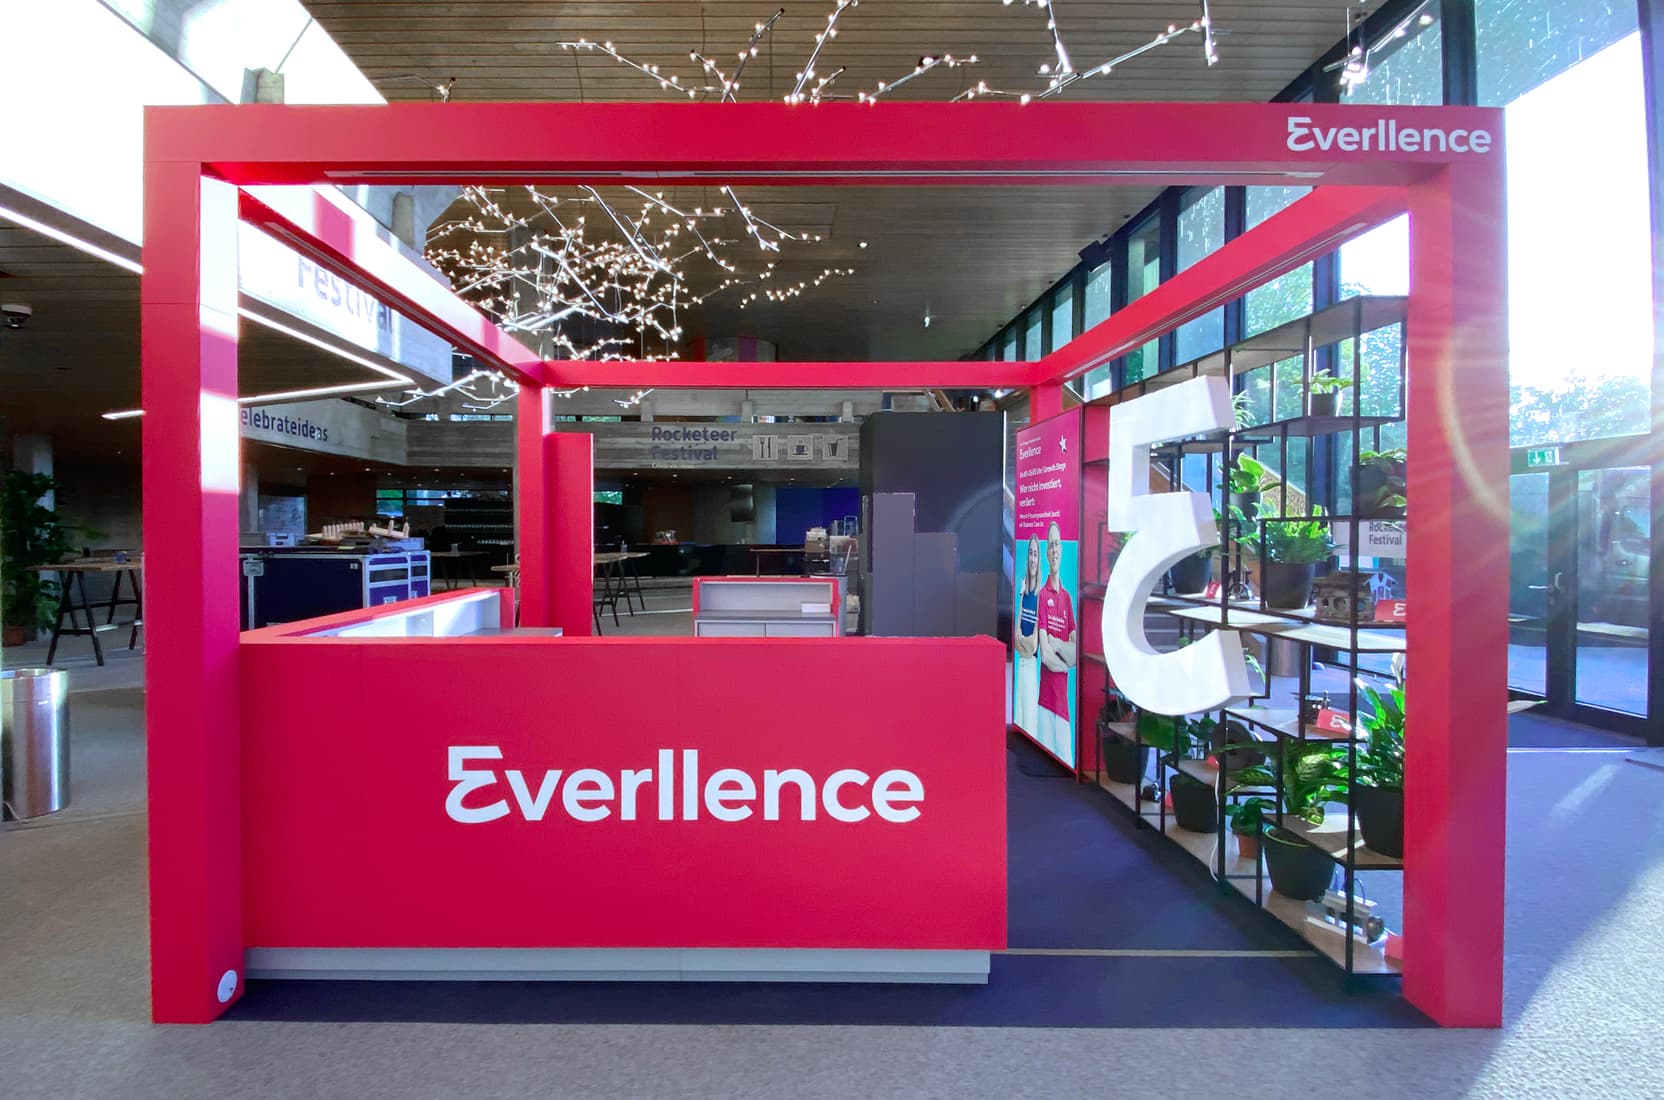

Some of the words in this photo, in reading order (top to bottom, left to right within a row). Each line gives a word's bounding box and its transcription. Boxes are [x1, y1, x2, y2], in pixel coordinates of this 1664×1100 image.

[1286, 116, 1492, 153] Everllence
[651, 426, 737, 442] Rocketeer
[651, 445, 718, 461] Festival
[1368, 534, 1402, 545] Festival
[444, 744, 926, 825] Everllence
